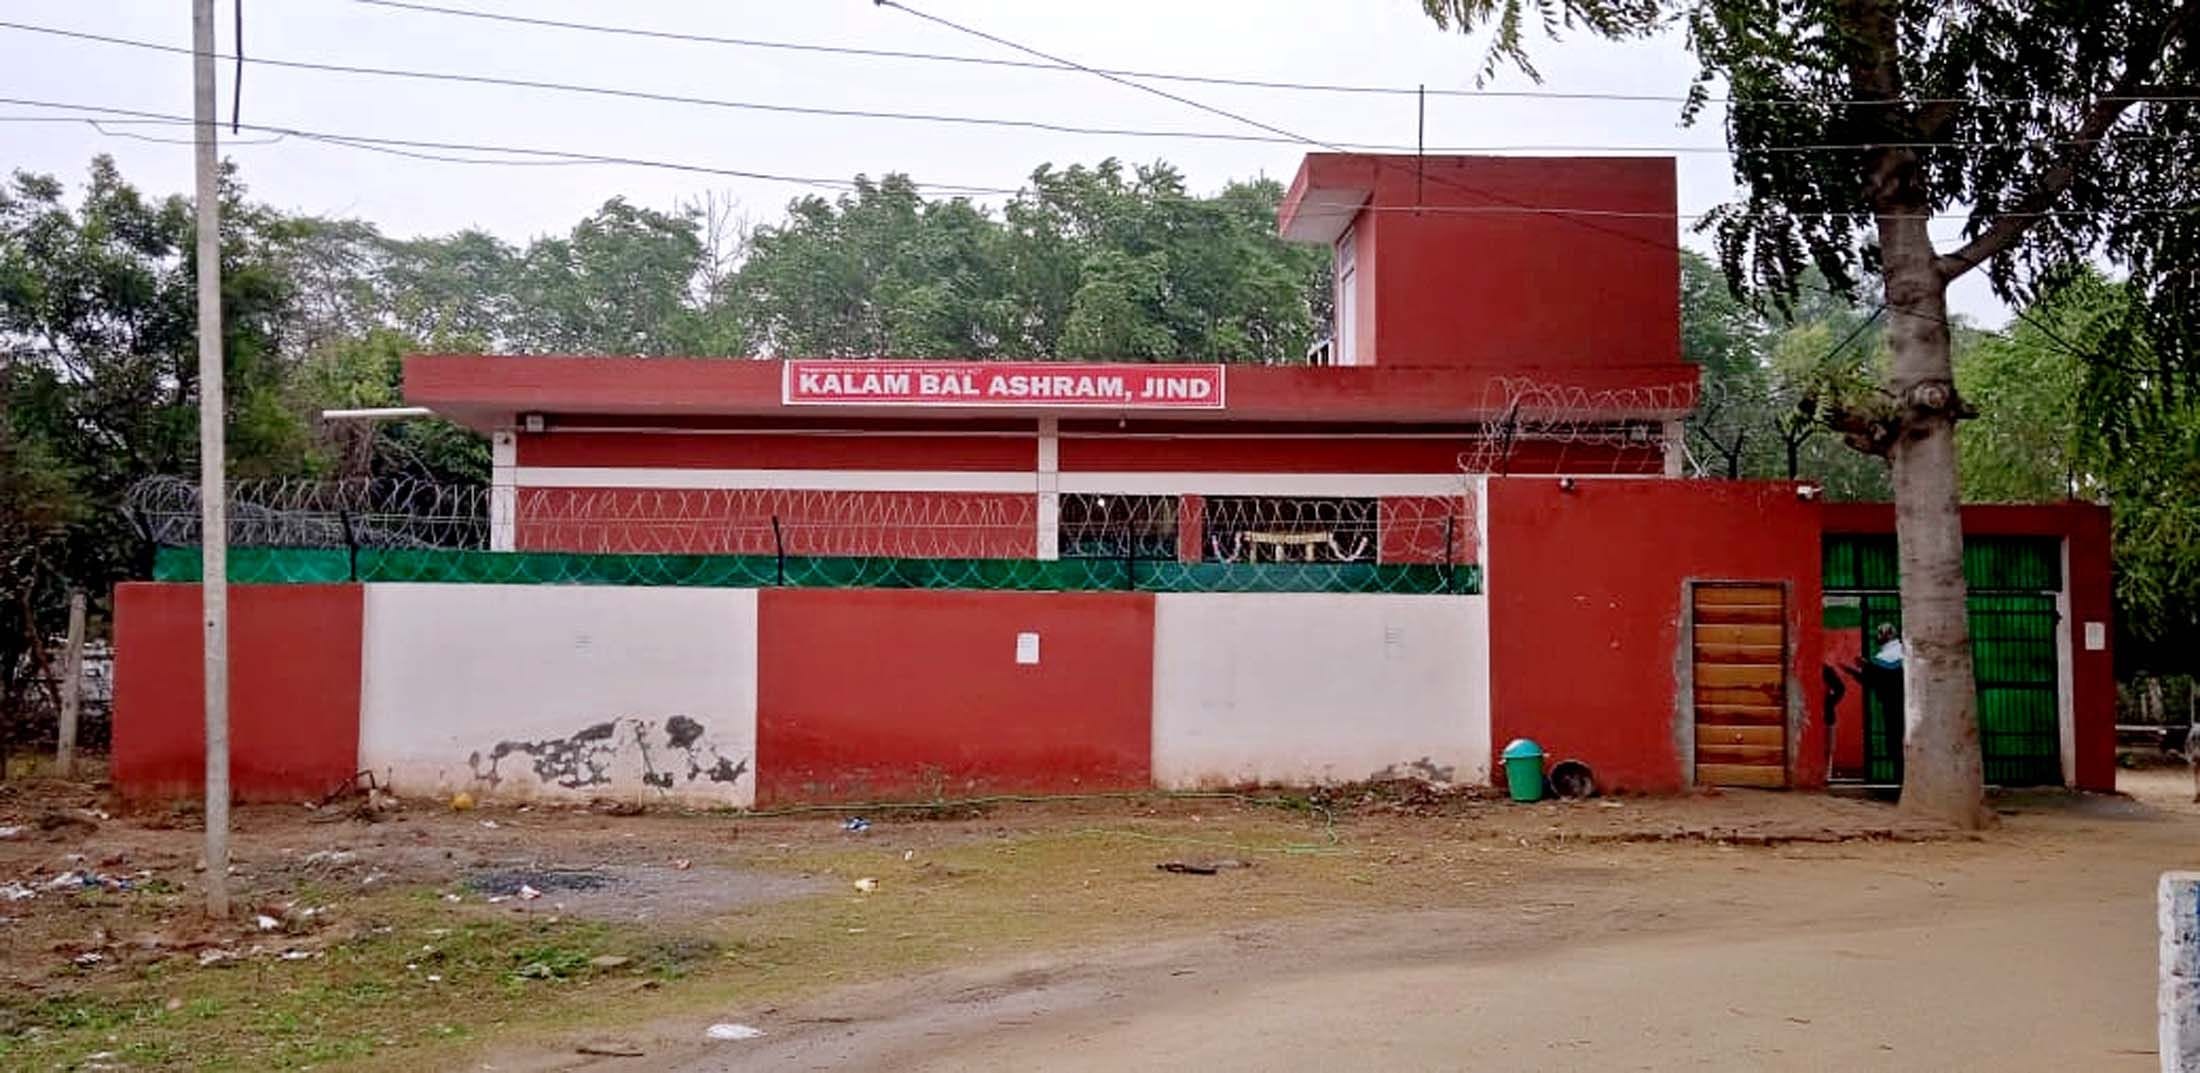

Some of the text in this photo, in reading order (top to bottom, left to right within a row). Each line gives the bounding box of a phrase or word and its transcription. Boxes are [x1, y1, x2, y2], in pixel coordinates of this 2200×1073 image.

[799, 374, 1211, 401] KALAM BAL ASHRAM, JIND
